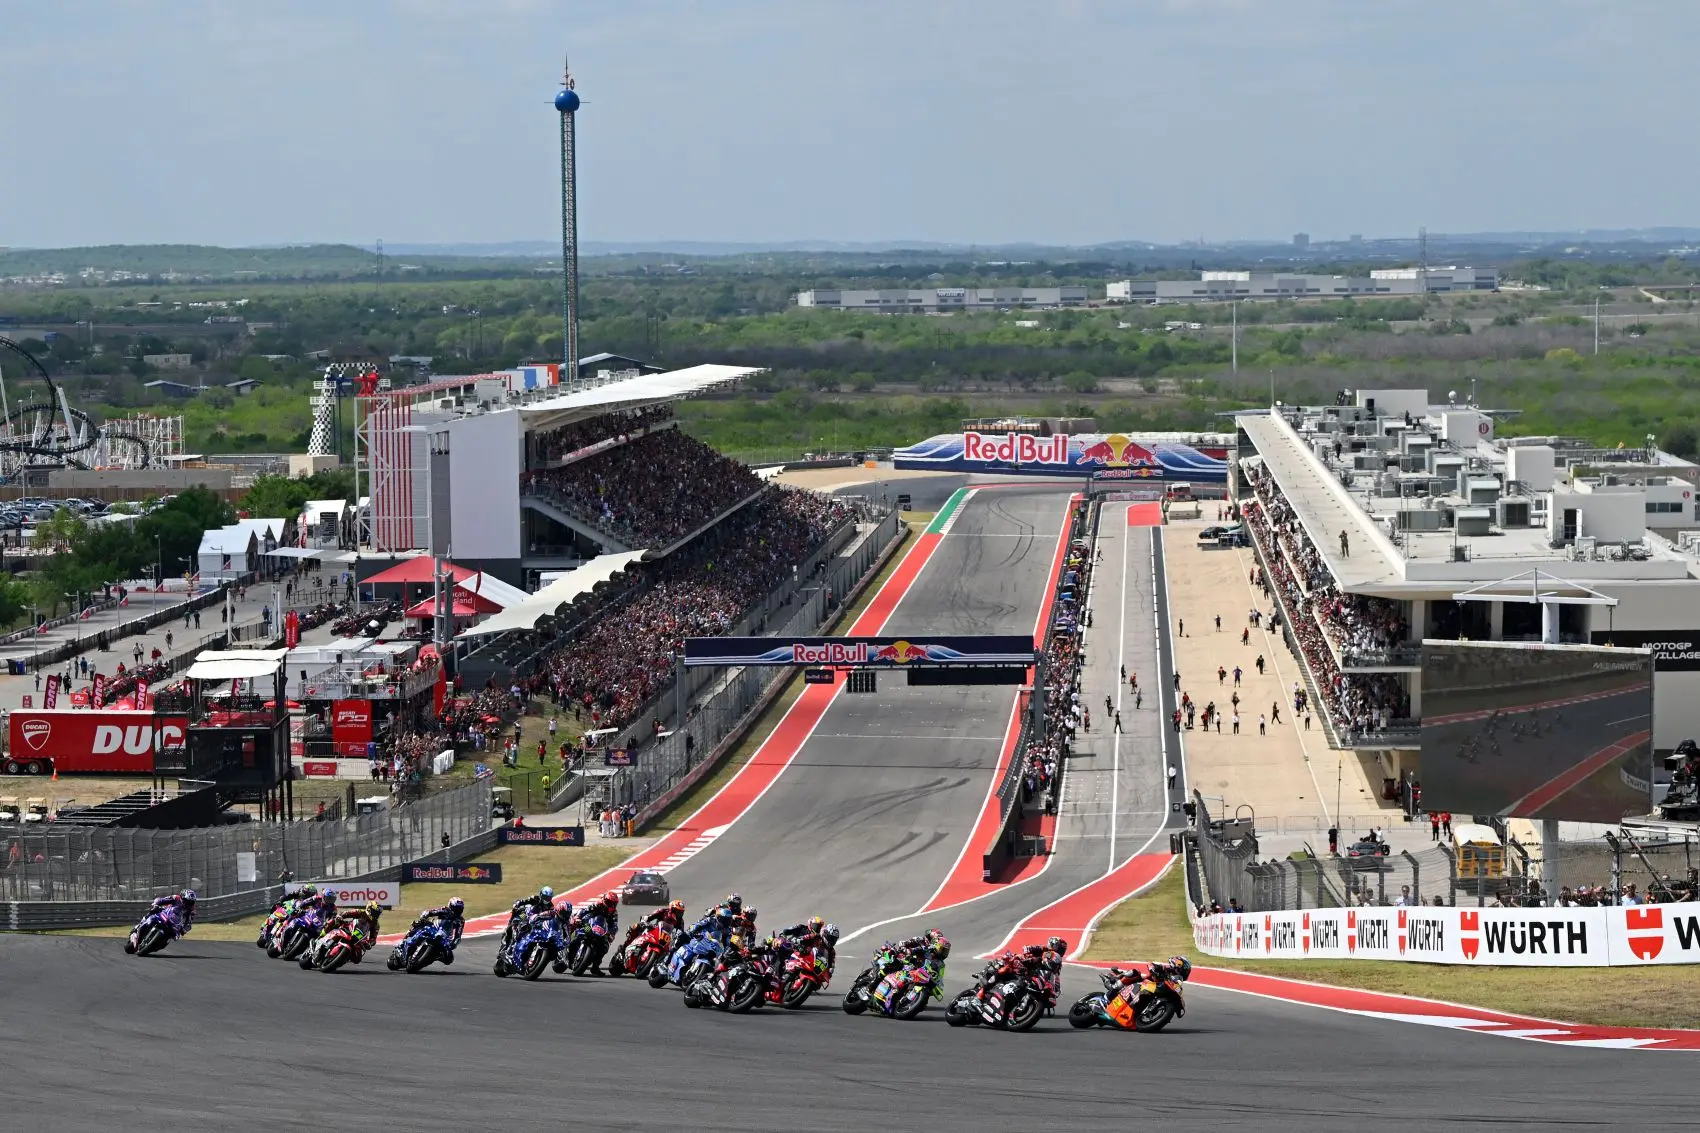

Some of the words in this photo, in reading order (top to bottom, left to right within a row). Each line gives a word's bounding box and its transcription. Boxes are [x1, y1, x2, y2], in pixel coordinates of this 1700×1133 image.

[964, 432, 1015, 462] Red
[1018, 434, 1068, 464] Bull
[1101, 469, 1116, 477] Red
[1117, 469, 1131, 477] Bull
[793, 643, 829, 662] Red
[831, 643, 867, 663] Bull
[1641, 642, 1692, 650] MOTOGP
[92, 725, 187, 755] DUC
[507, 830, 525, 841] Red
[525, 830, 543, 840] Bull
[413, 867, 433, 879] Red
[433, 867, 454, 878] Bull
[1272, 922, 1296, 950] WÜRTH
[1312, 920, 1339, 949] WÜRTH
[1357, 919, 1388, 950] WÜRTH
[1408, 919, 1444, 951] WÜRTH
[1484, 921, 1587, 954] WÜRTH
